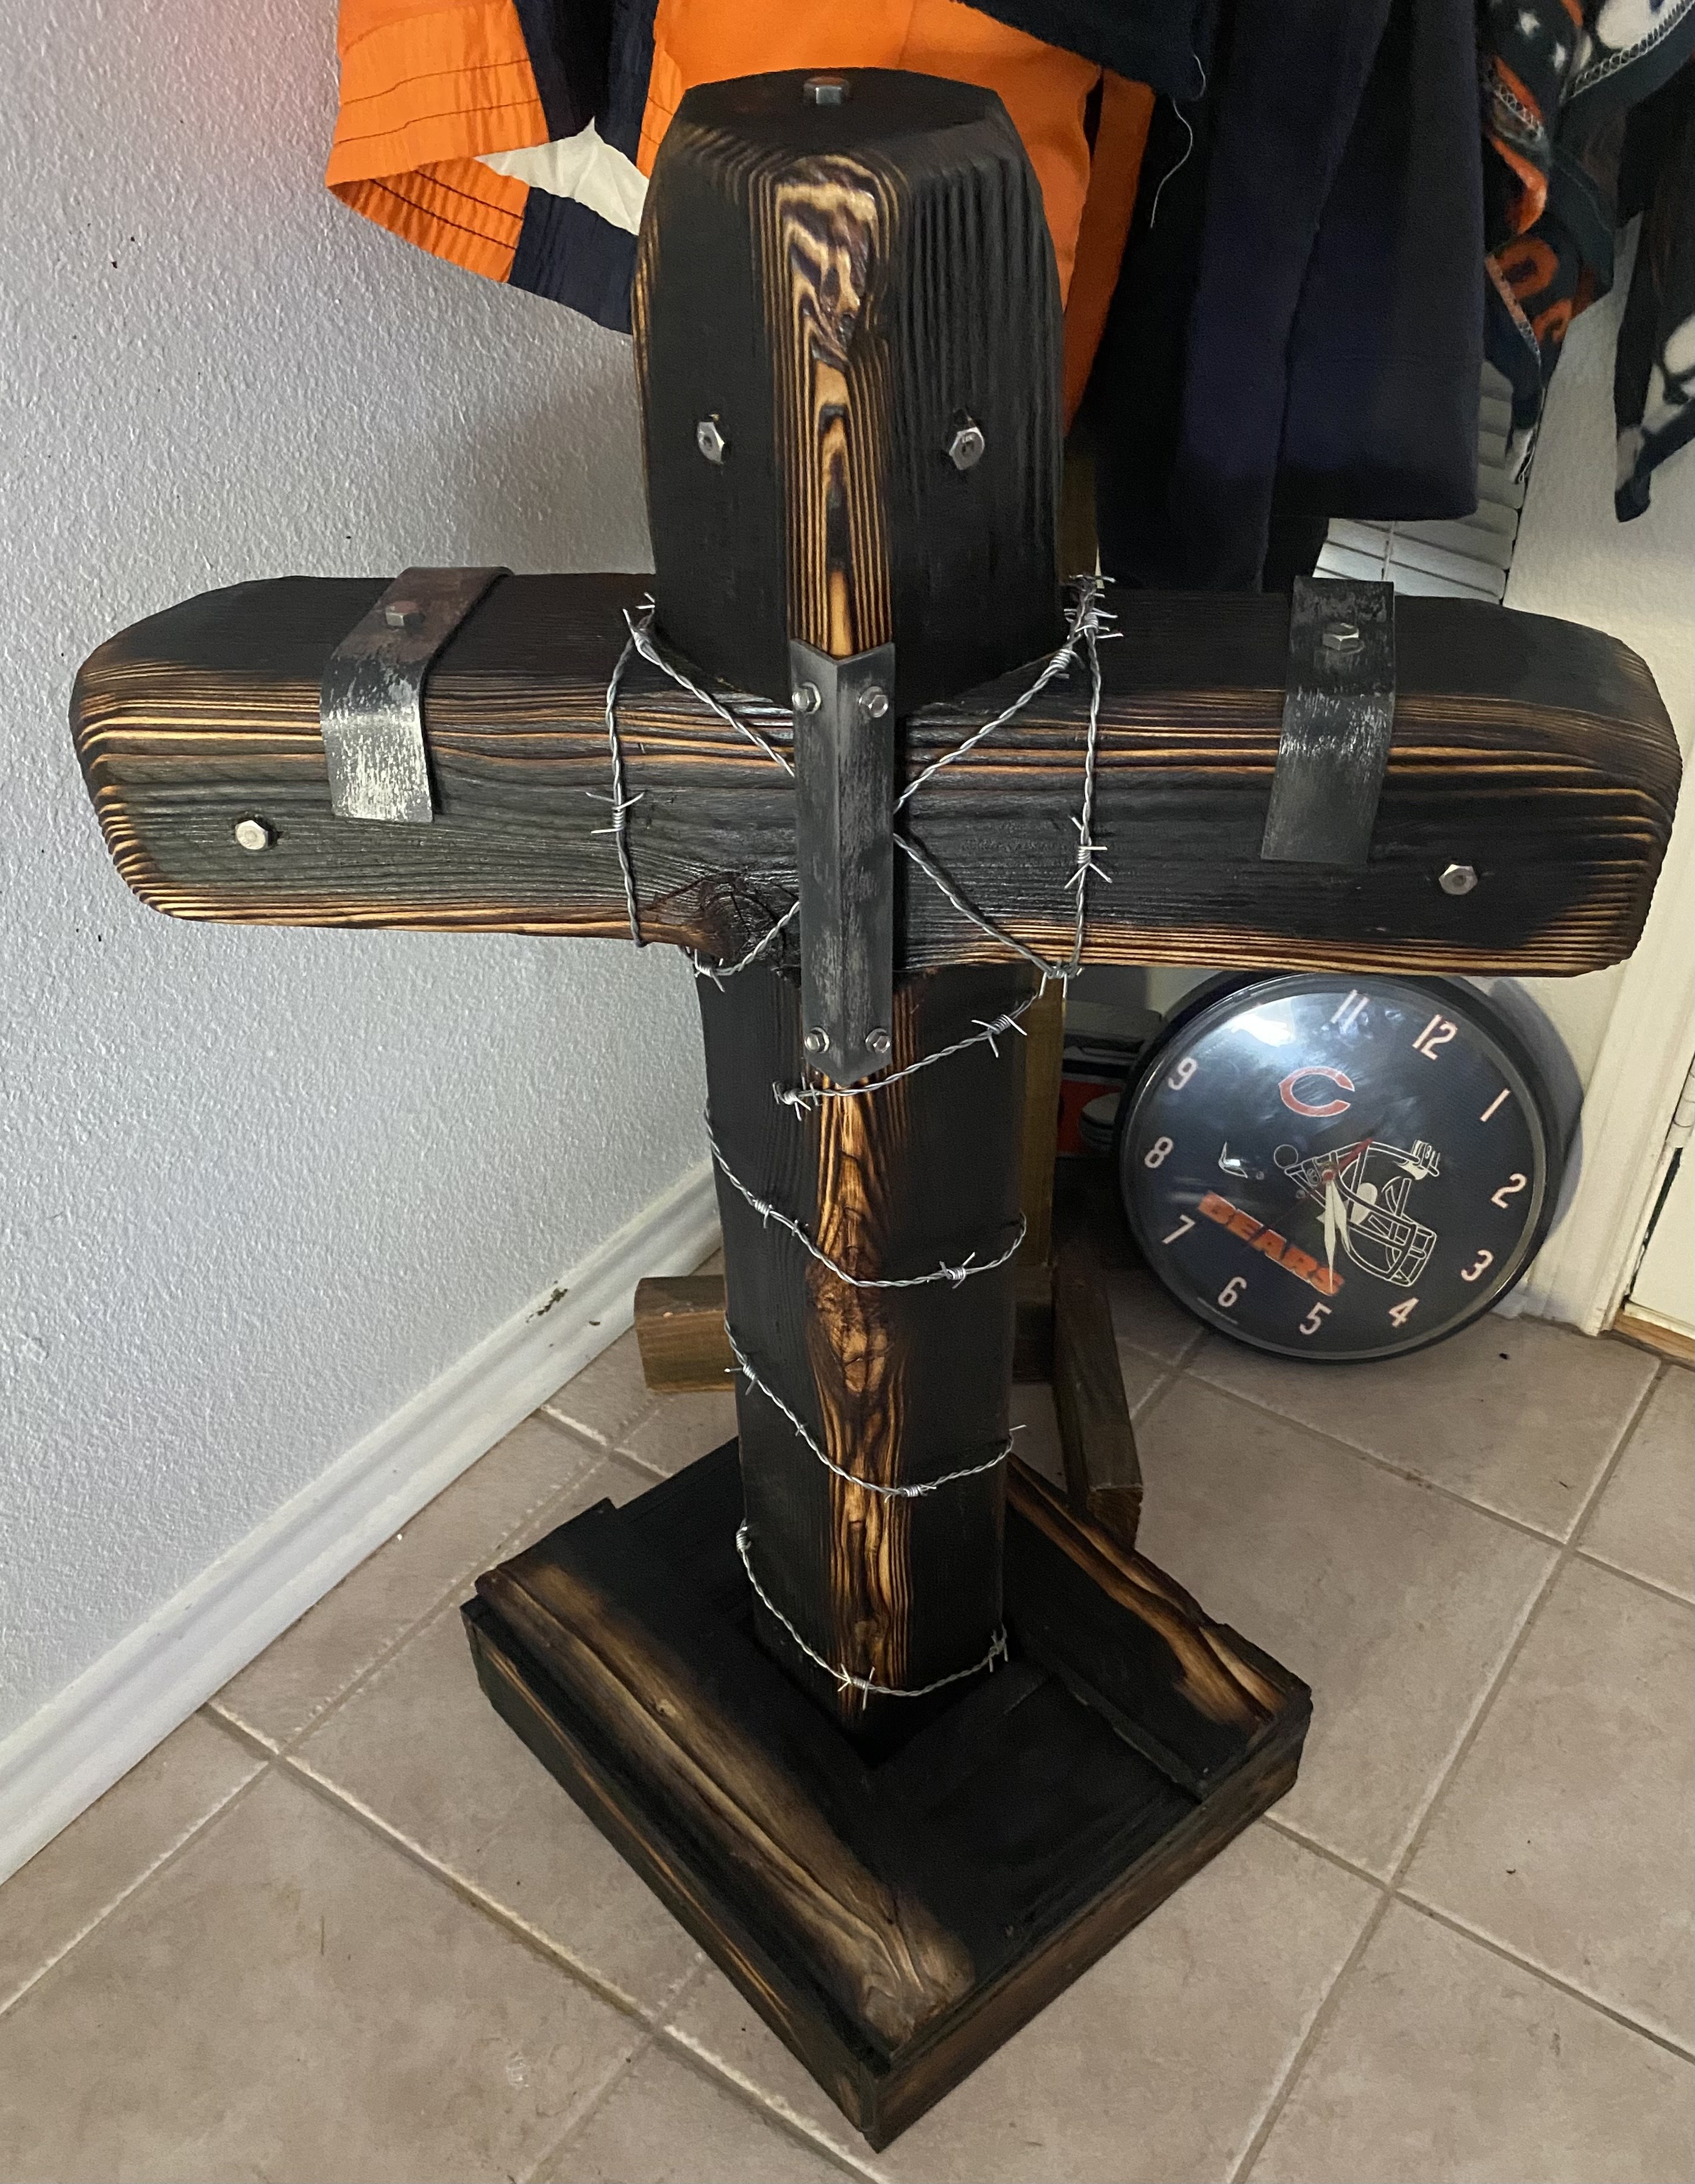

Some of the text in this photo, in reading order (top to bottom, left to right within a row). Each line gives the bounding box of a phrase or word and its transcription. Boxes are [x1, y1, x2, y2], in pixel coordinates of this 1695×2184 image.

[1412, 1014, 1458, 1060] 12
[1168, 1058, 1198, 1090] 9
[1279, 1065, 1355, 1117] C
[1479, 1087, 1510, 1122] 1
[1144, 1136, 1173, 1168] 8
[1491, 1173, 1527, 1209] 2
[1162, 1214, 1195, 1244] 7
[1198, 1190, 1345, 1297] BEARS
[1461, 1250, 1494, 1281] 3
[1218, 1276, 1247, 1307] 6
[1299, 1302, 1332, 1335] 5
[1388, 1297, 1420, 1328] 4
